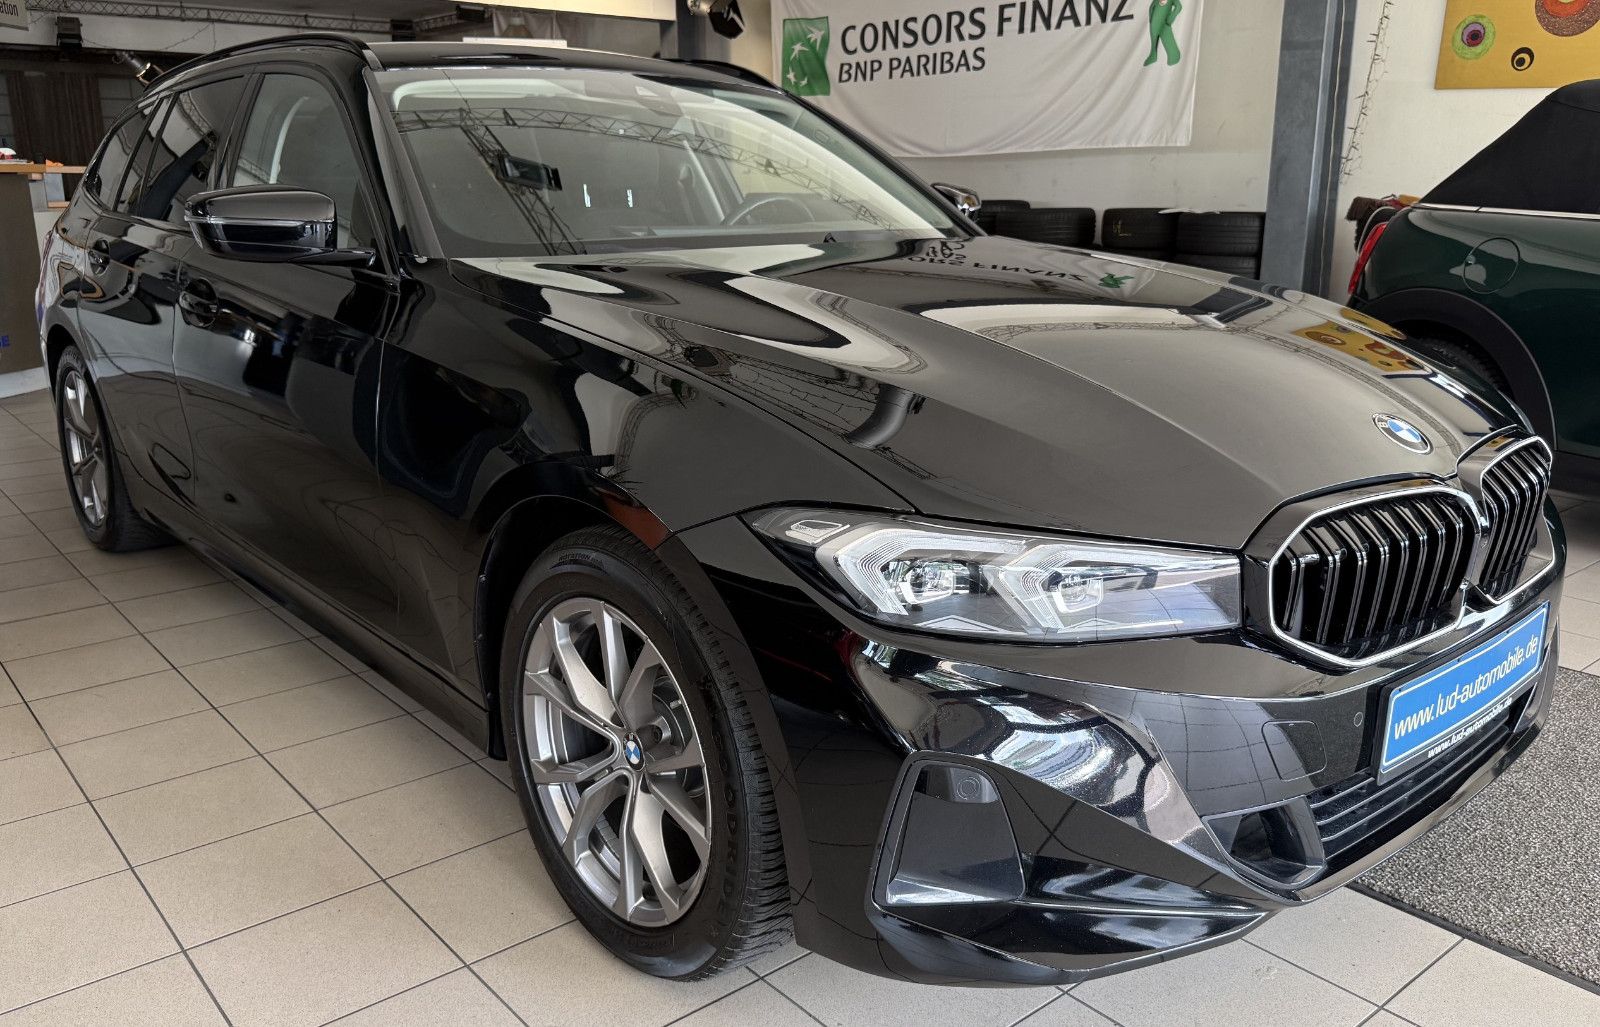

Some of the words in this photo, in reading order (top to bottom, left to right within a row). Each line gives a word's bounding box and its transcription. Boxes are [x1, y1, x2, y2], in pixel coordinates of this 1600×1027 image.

[840, 7, 986, 56] CONSORS
[997, 0, 1135, 37] FINANZ
[838, 59, 883, 83] BNP
[889, 47, 986, 79] PARIBAS
[1394, 635, 1538, 740] www.lud-automobile.de
